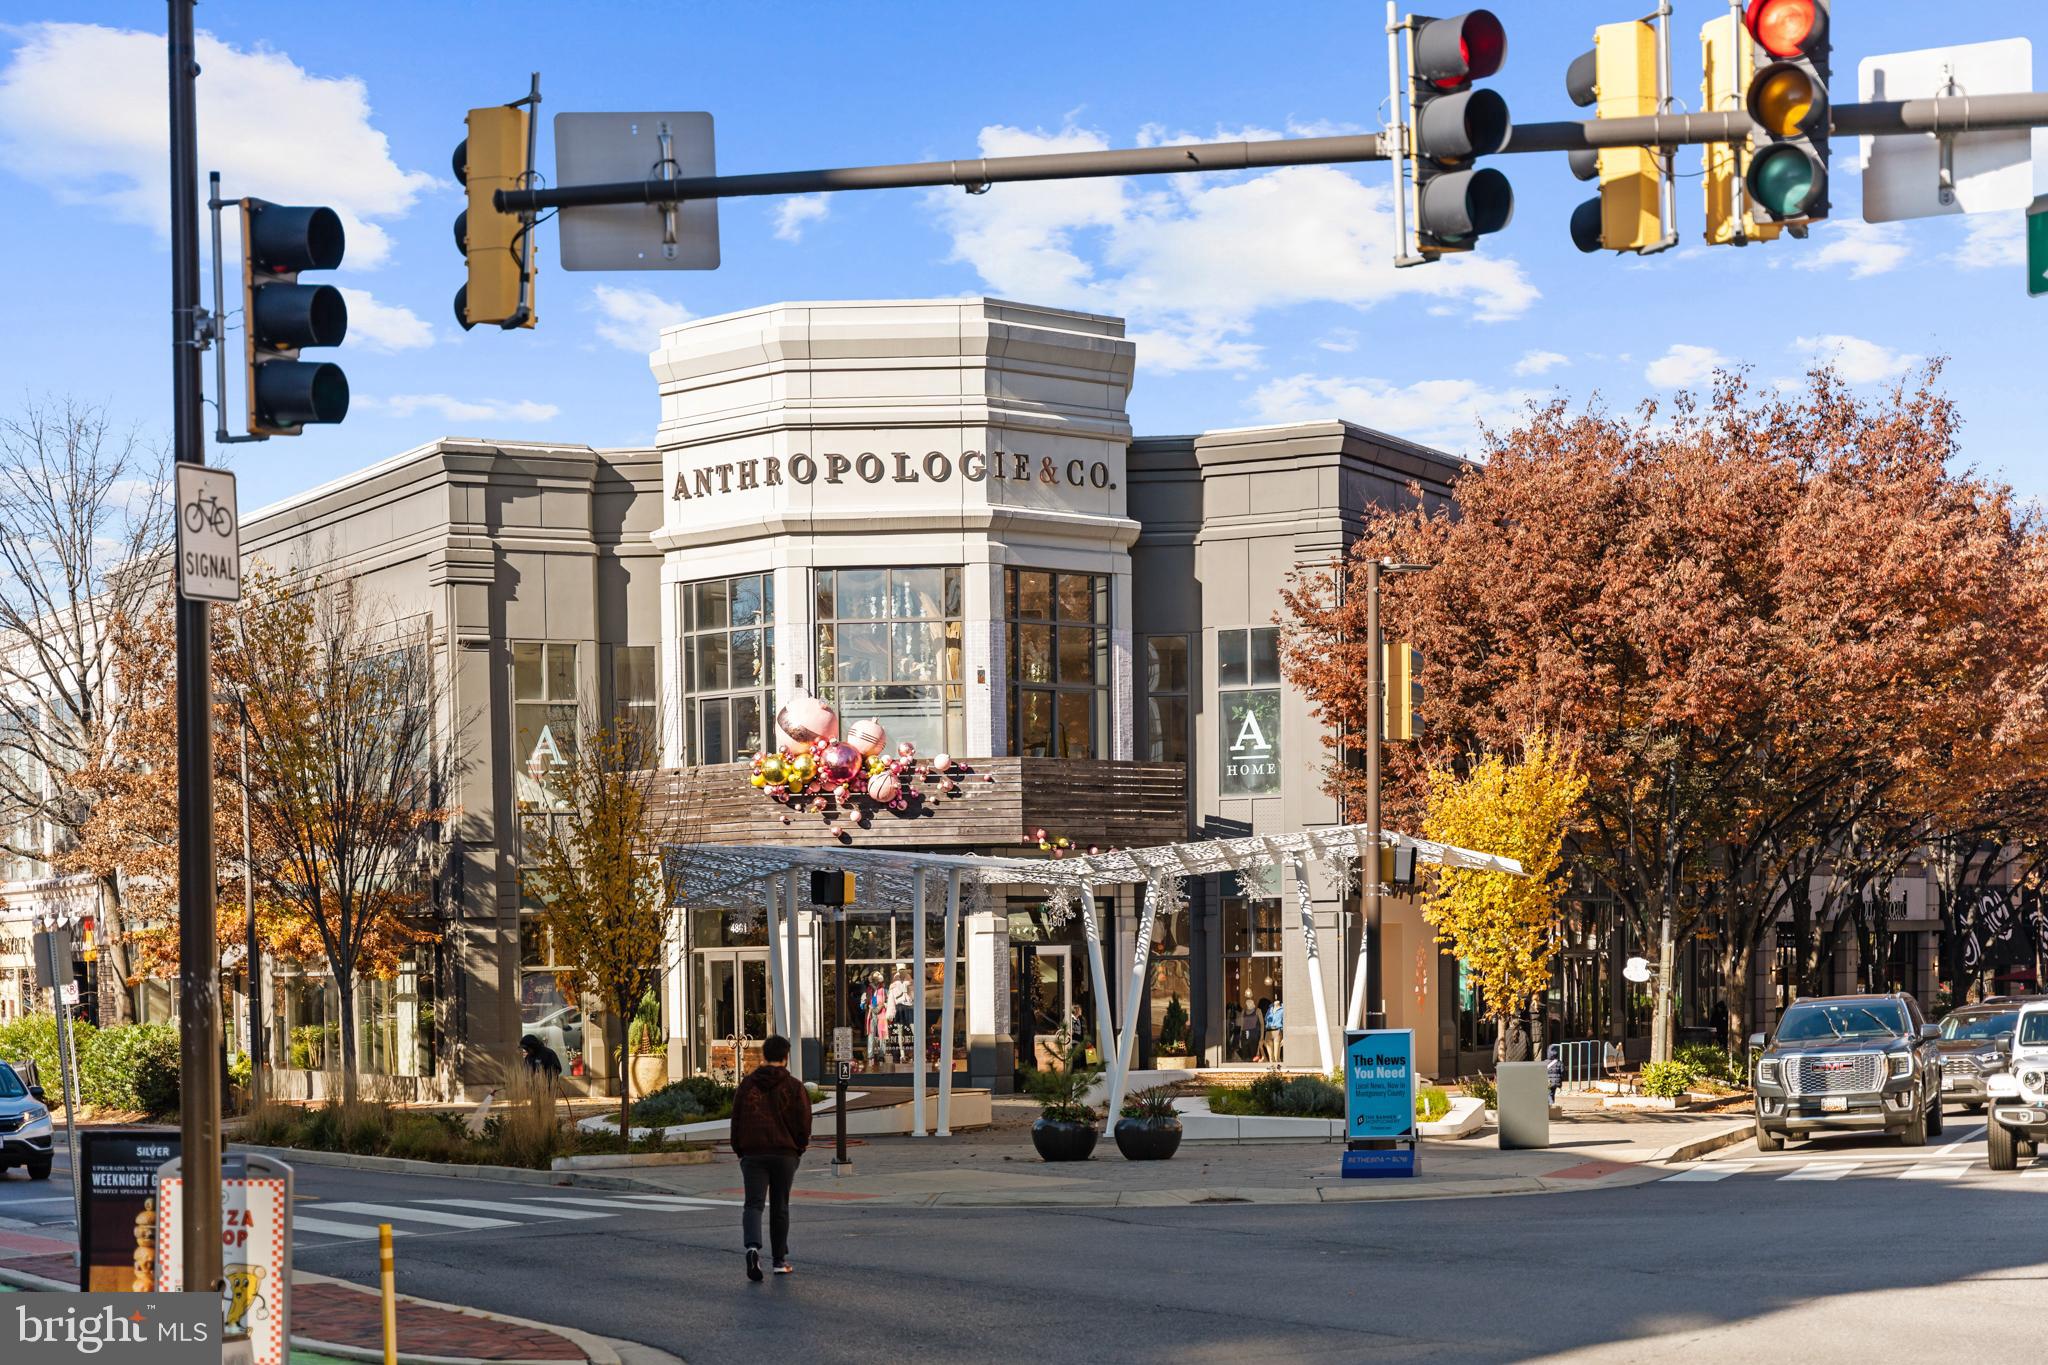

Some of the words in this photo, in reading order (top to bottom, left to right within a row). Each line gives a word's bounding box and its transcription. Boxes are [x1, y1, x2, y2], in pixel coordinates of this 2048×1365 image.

[186, 552, 236, 581] SIGNAL
[1230, 709, 1272, 751] A
[525, 725, 568, 765] A
[1226, 763, 1276, 776] HOME
[1353, 1054, 1374, 1066] The
[1376, 1054, 1406, 1066] News
[1812, 1062, 1853, 1071] GMC
[1354, 1066, 1374, 1079] You
[1376, 1065, 1406, 1079] Need
[136, 1145, 170, 1158] SILVER
[92, 1173, 149, 1187] WEEKNIGHT
